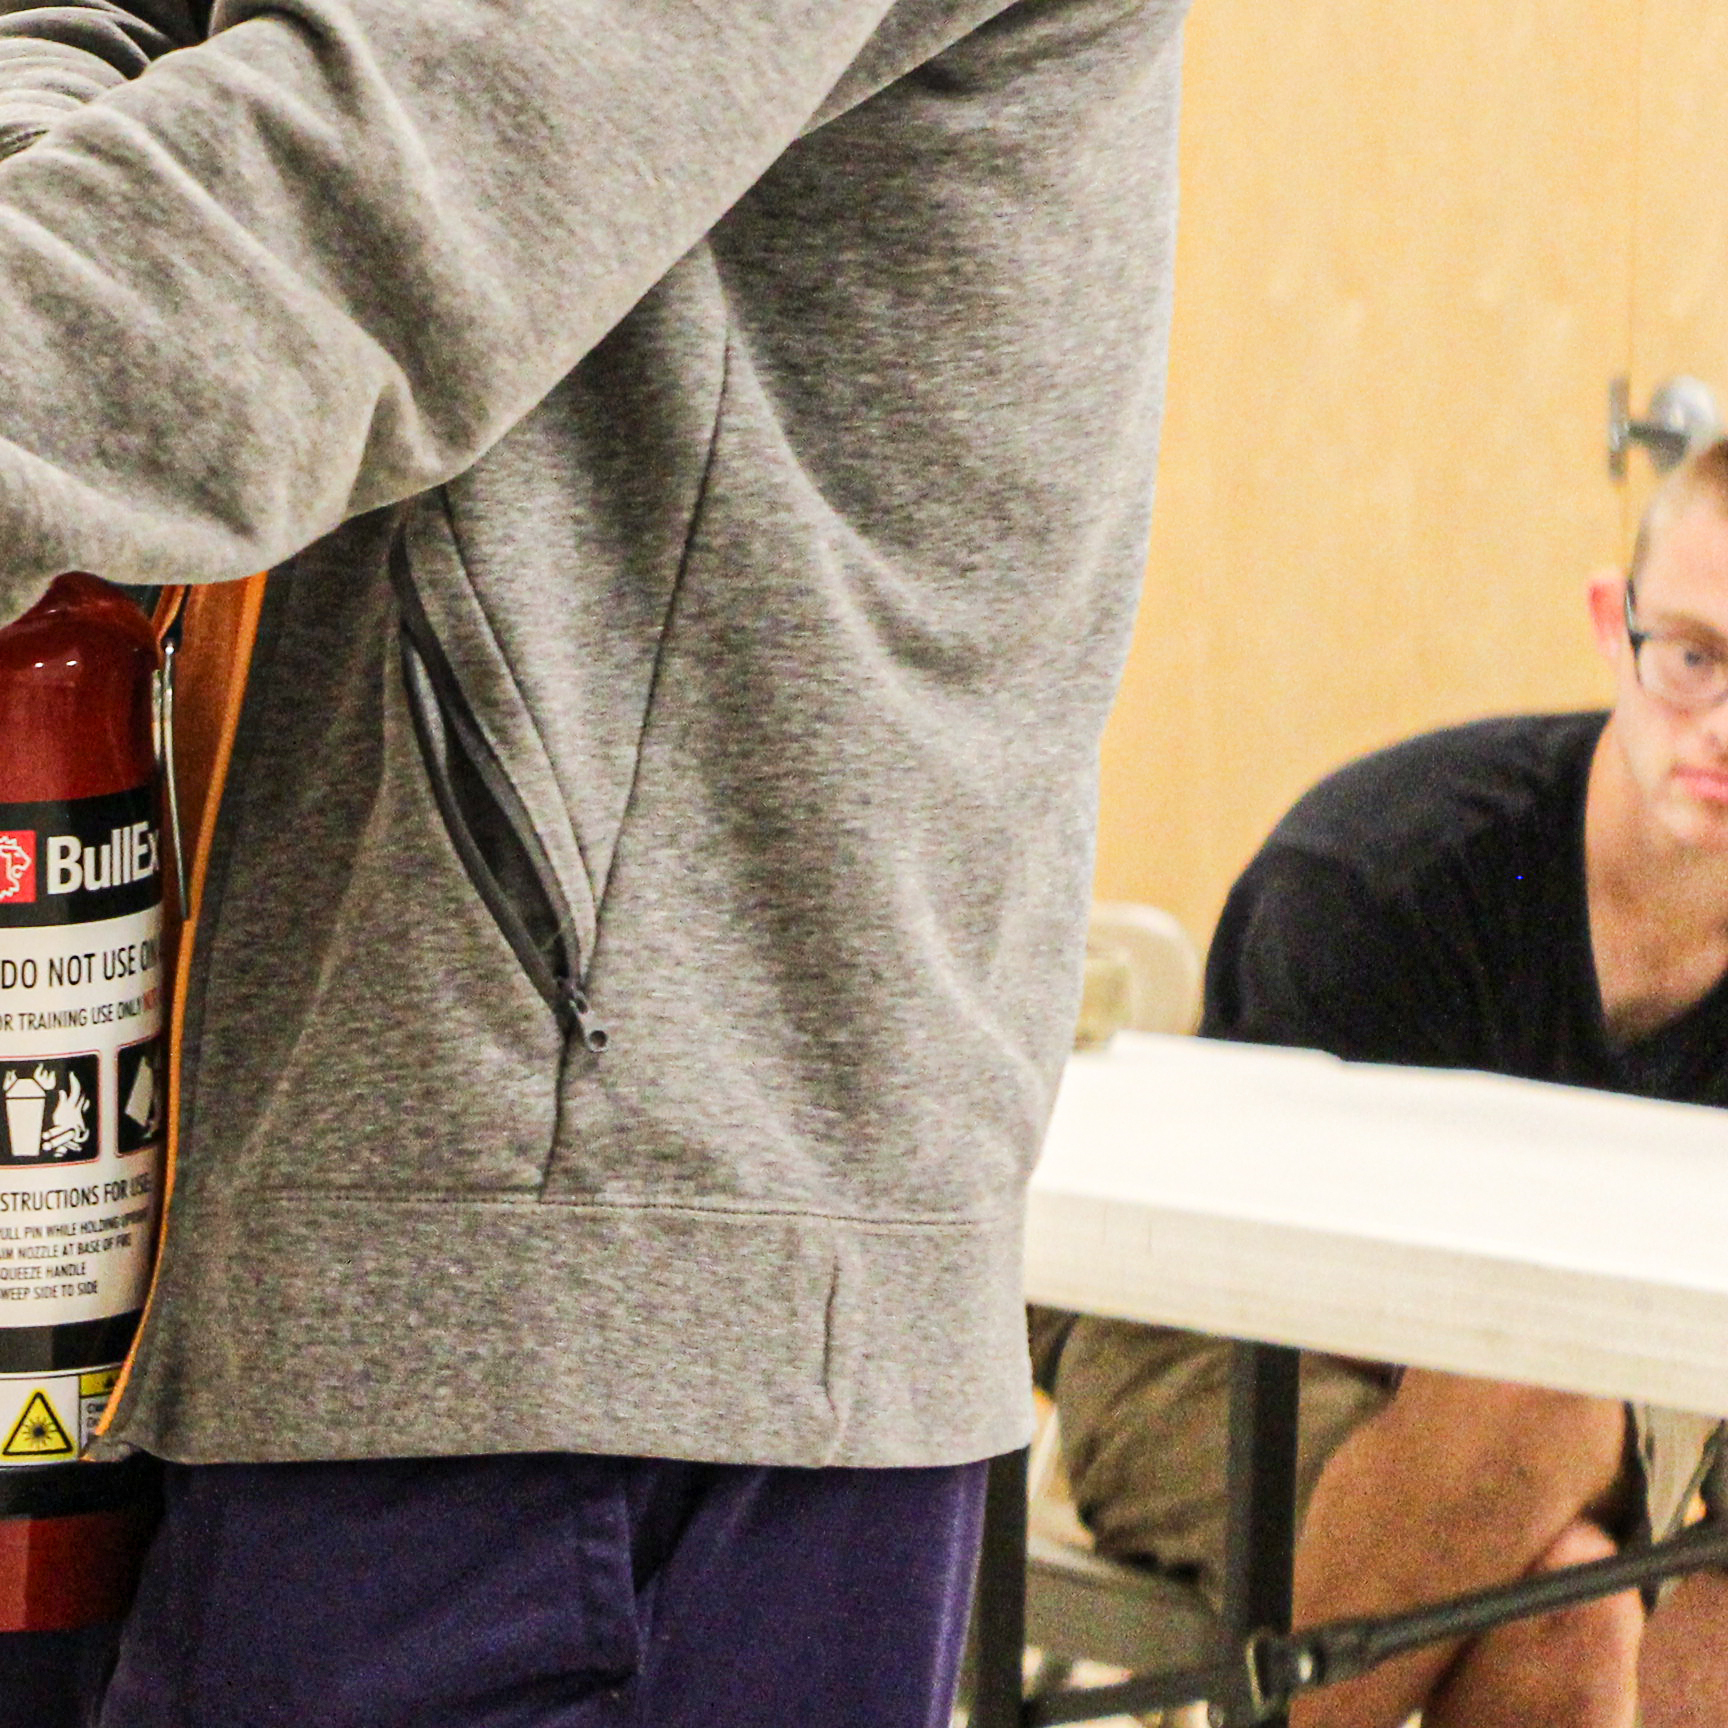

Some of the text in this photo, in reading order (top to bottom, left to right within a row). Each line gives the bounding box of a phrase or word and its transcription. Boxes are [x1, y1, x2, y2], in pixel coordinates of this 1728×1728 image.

[0, 958, 38, 989] DO
[48, 953, 95, 988] NOT
[103, 944, 136, 981] USE
[18, 1009, 87, 1031] TRAINING
[92, 1003, 114, 1025] USE
[104, 1179, 128, 1203] FOR
[24, 1226, 43, 1239] PIN
[46, 1222, 76, 1238] WHILE
[18, 1244, 58, 1260] NOZZLE
[62, 1243, 74, 1255] AT
[77, 1239, 100, 1255] BASE
[46, 1261, 86, 1277] HANDLE
[34, 1285, 58, 1300] SIDE
[62, 1284, 74, 1297] TO
[77, 1280, 98, 1296] SIDE
